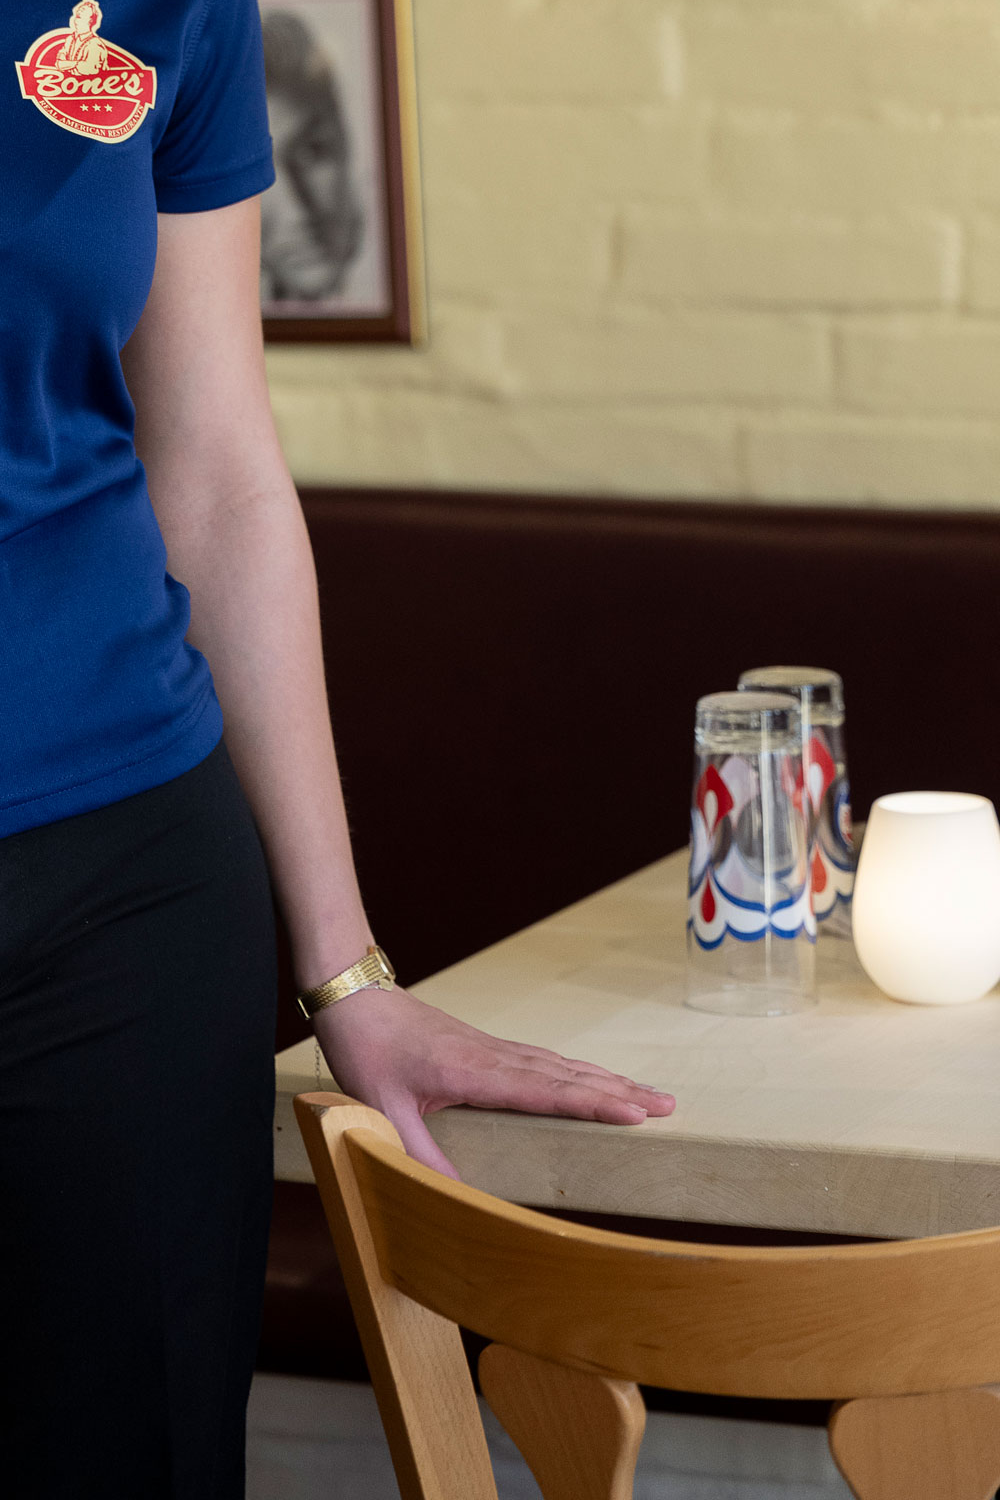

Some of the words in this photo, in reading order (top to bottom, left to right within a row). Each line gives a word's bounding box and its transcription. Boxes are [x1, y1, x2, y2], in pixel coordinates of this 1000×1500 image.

[33, 69, 144, 97] Bone's
[39, 99, 58, 119] REAL
[60, 117, 106, 137] AMERICAN
[108, 104, 144, 138] RESTAURANTS
